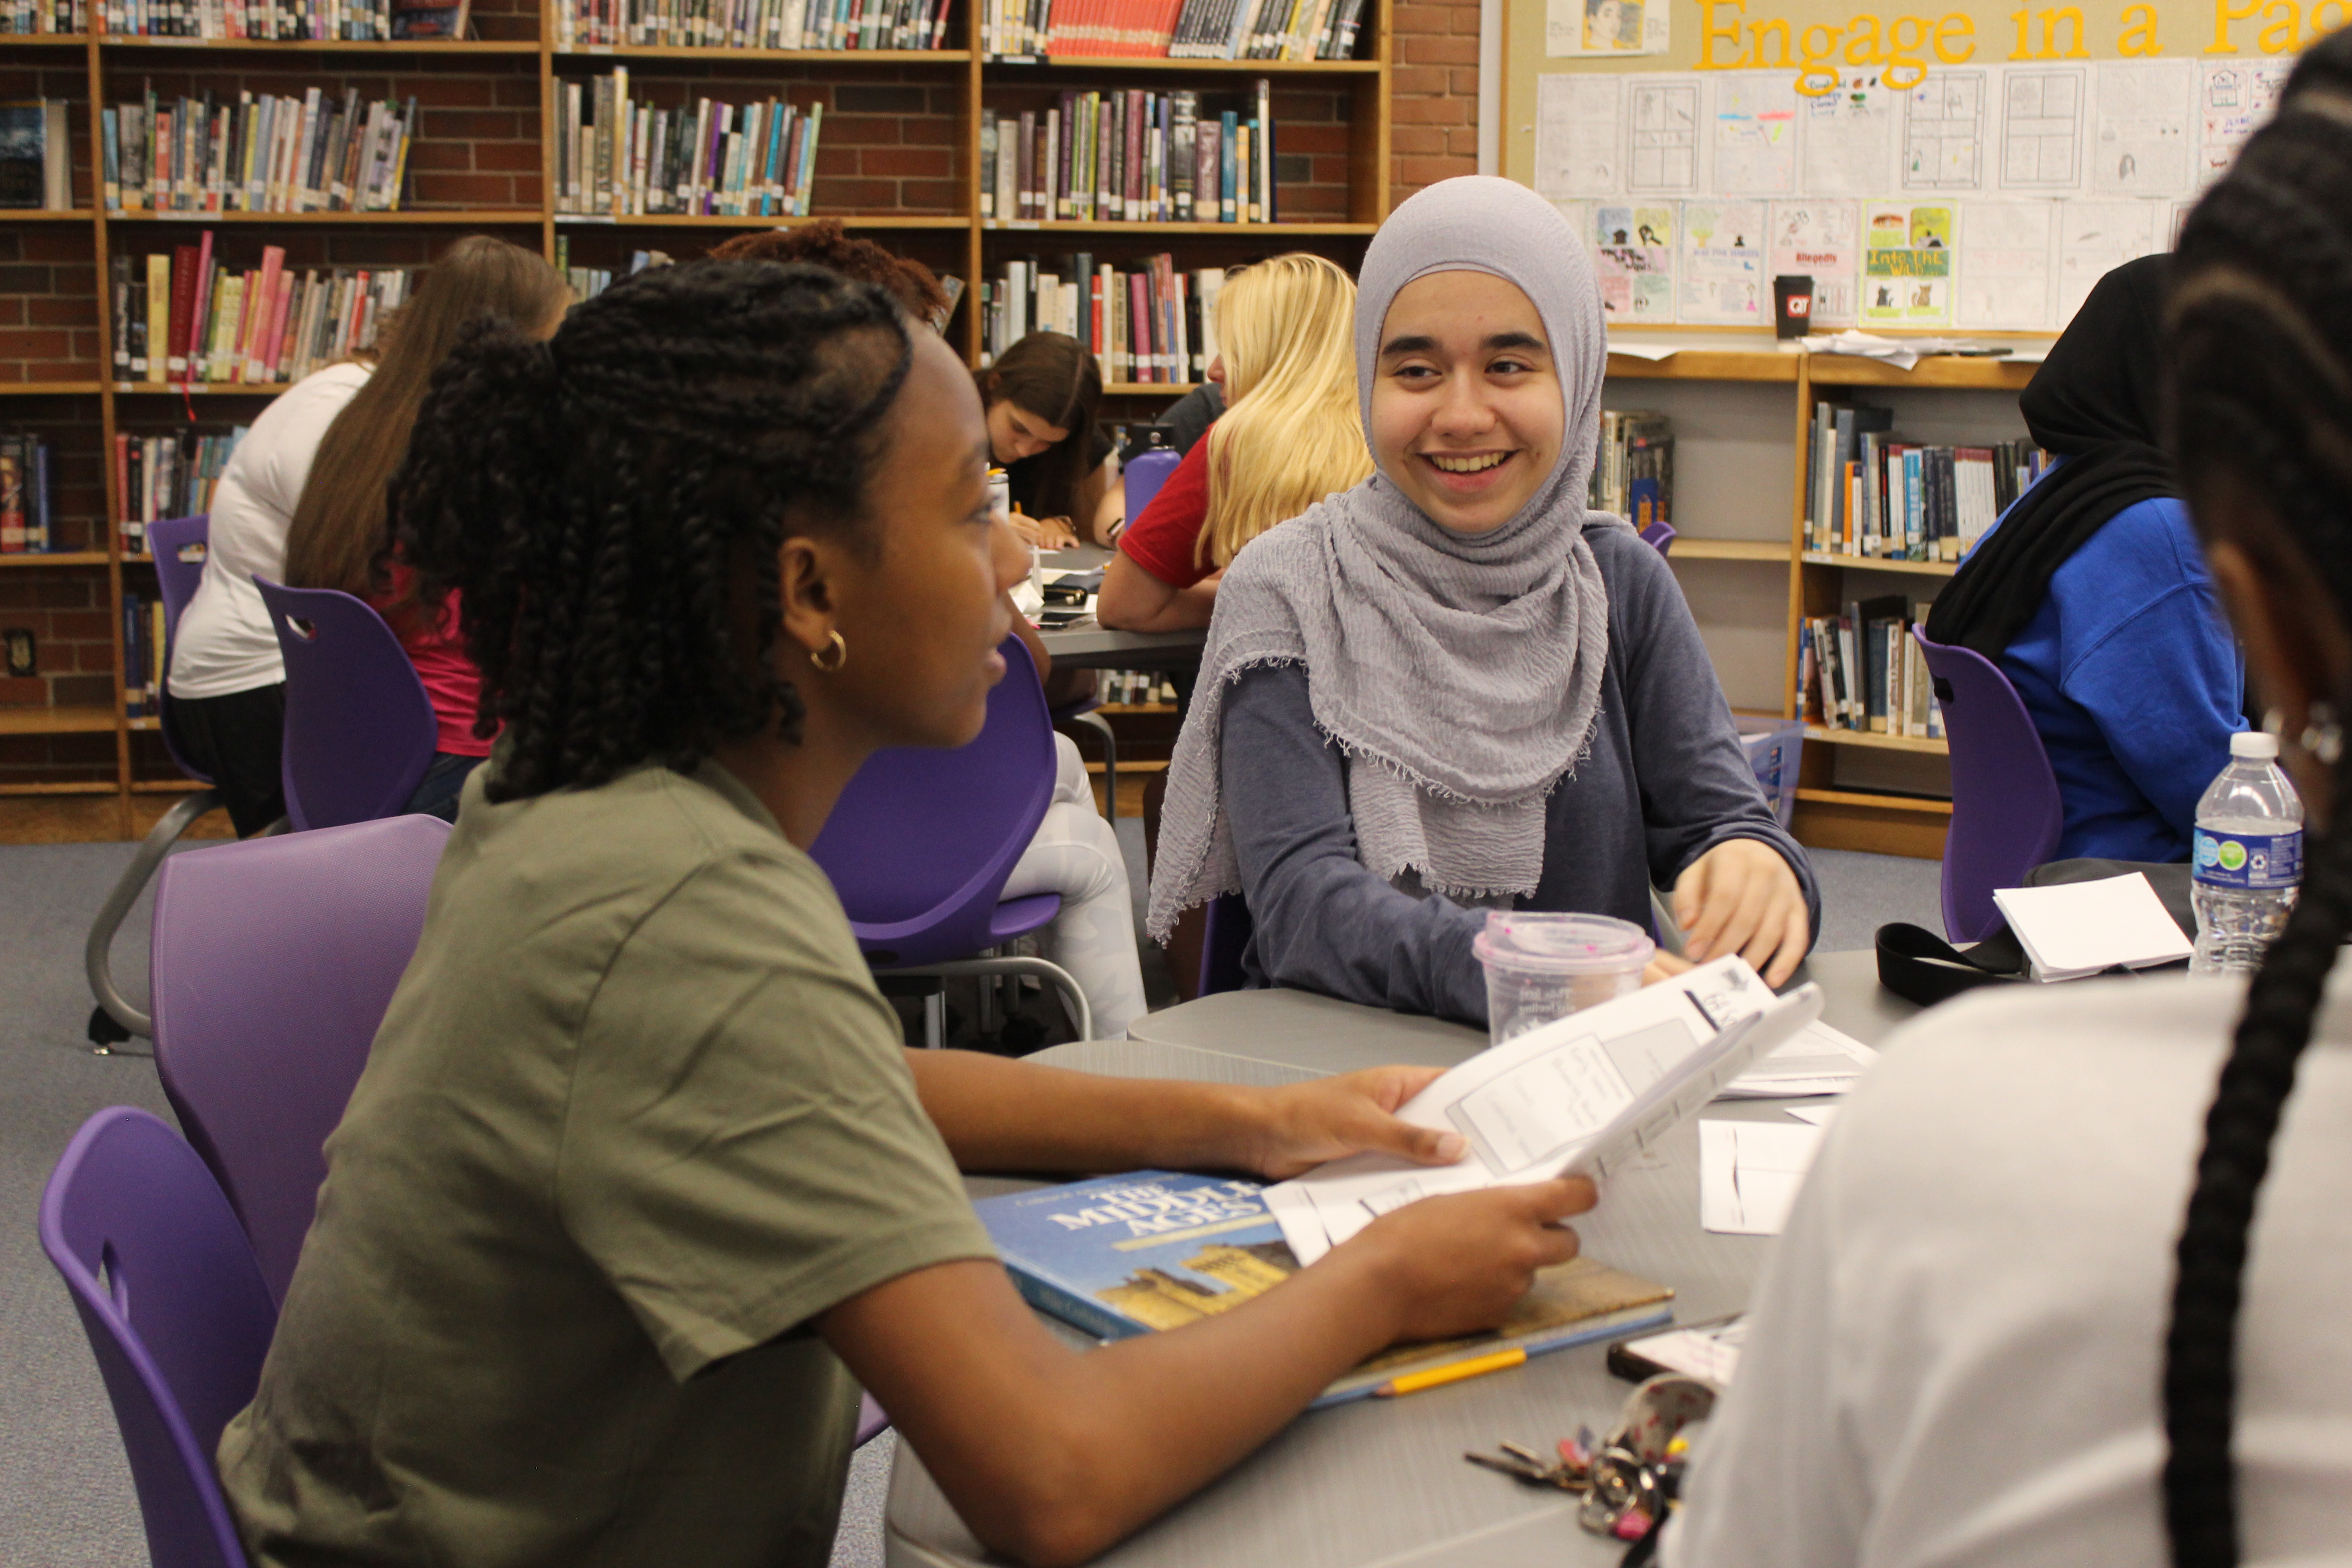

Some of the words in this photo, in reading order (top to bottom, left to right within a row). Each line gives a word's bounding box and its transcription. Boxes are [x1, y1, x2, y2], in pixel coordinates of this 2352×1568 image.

[1693, 0, 1975, 96] Engage
[2008, 0, 2091, 60] in
[2117, 3, 2164, 58] a
[1869, 250, 1906, 265] Into
[1789, 298, 1810, 314] QT
[1047, 1181, 1262, 1230] MIDDLE
[1127, 1201, 1262, 1236] AGES
